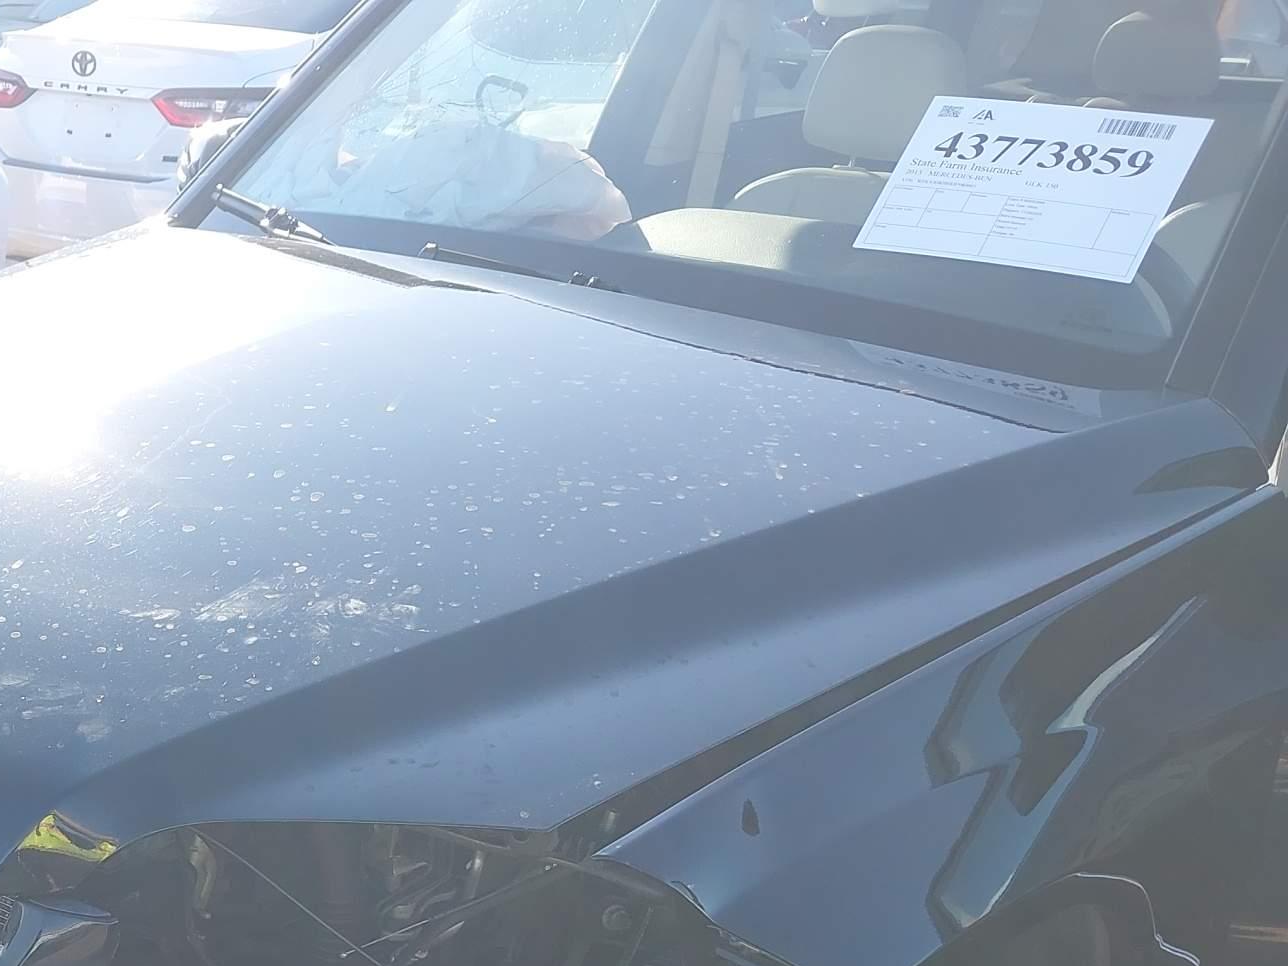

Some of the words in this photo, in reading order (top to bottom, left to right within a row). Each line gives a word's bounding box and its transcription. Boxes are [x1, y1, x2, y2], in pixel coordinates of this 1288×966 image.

[44, 81, 128, 95] CAMRY
[934, 131, 1154, 178] 43773859
[910, 158, 937, 168] State
[939, 160, 968, 172] Farm
[970, 162, 1023, 176] Insurance
